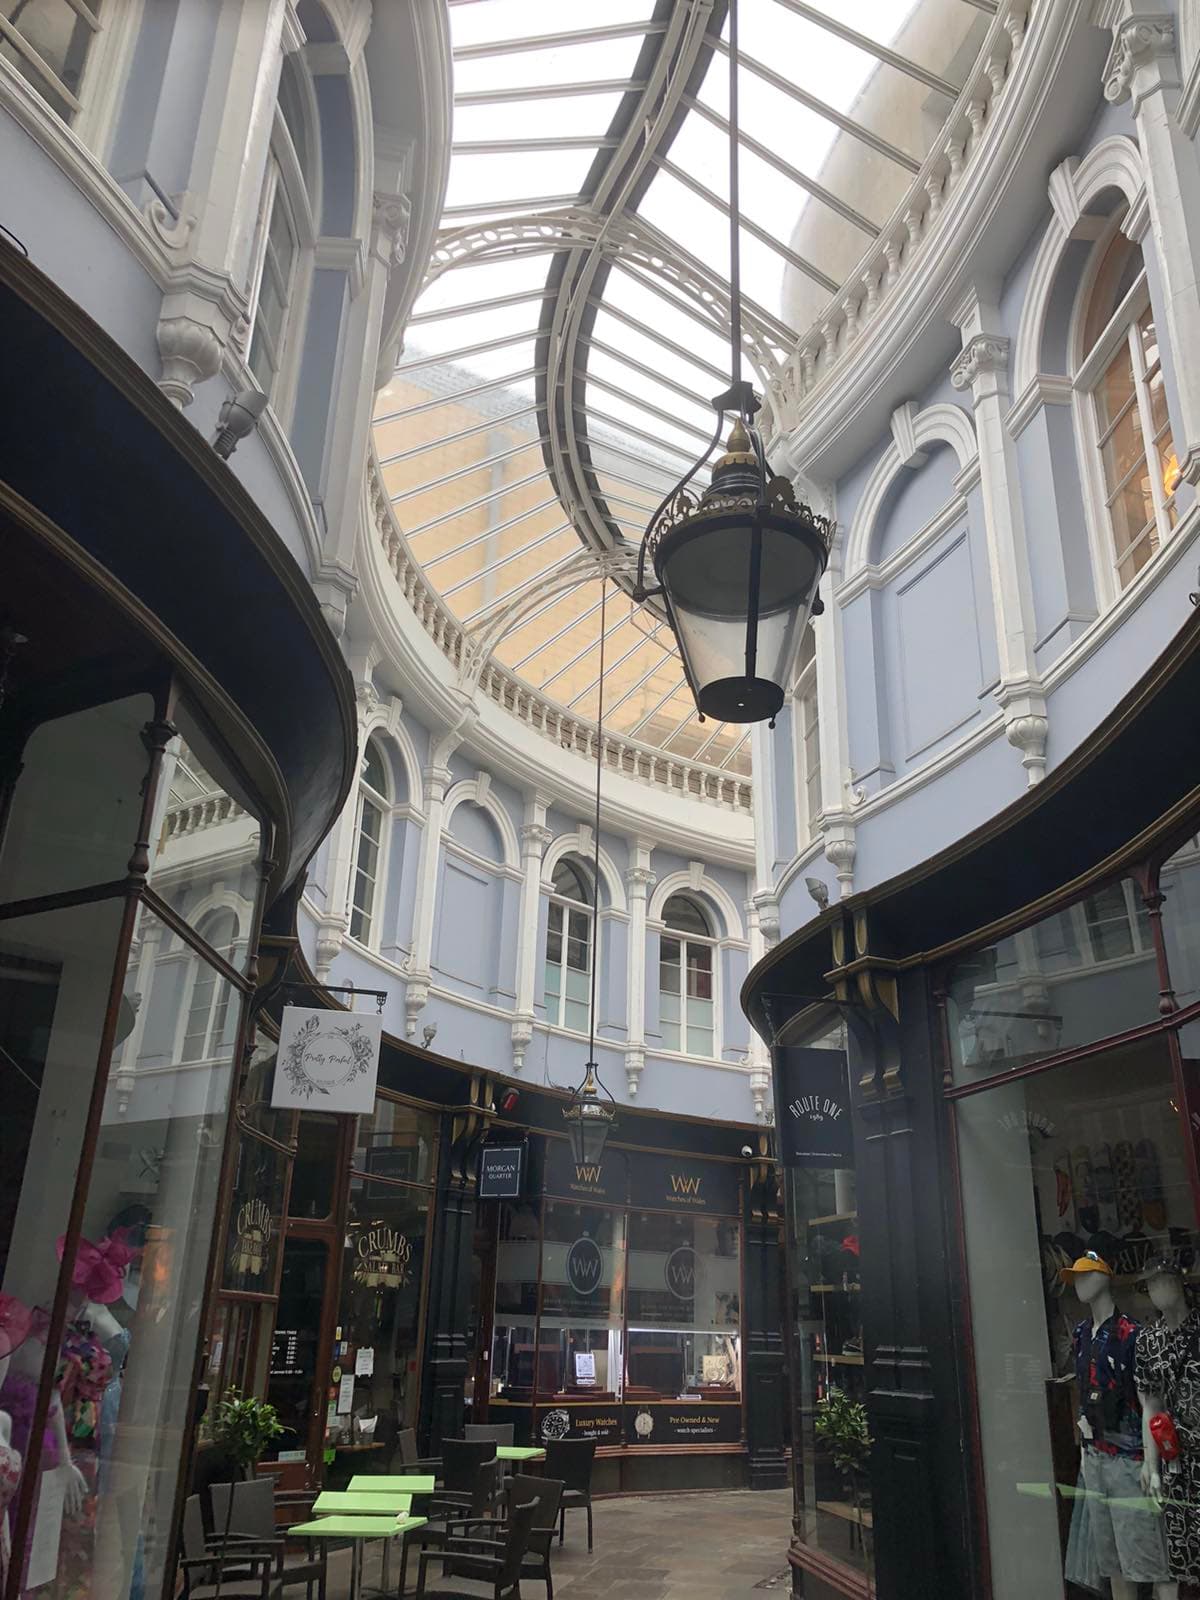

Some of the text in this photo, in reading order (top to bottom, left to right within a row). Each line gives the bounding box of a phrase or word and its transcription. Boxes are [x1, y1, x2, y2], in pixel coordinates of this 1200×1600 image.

[789, 1095, 843, 1121] ROUTE ONE
[237, 1198, 273, 1242] CRUMBS
[358, 1226, 413, 1263] CRUMBS
[575, 1418, 617, 1429] Luxury Watches
[669, 1416, 679, 1424] Pre
[680, 1416, 700, 1424] Owned
